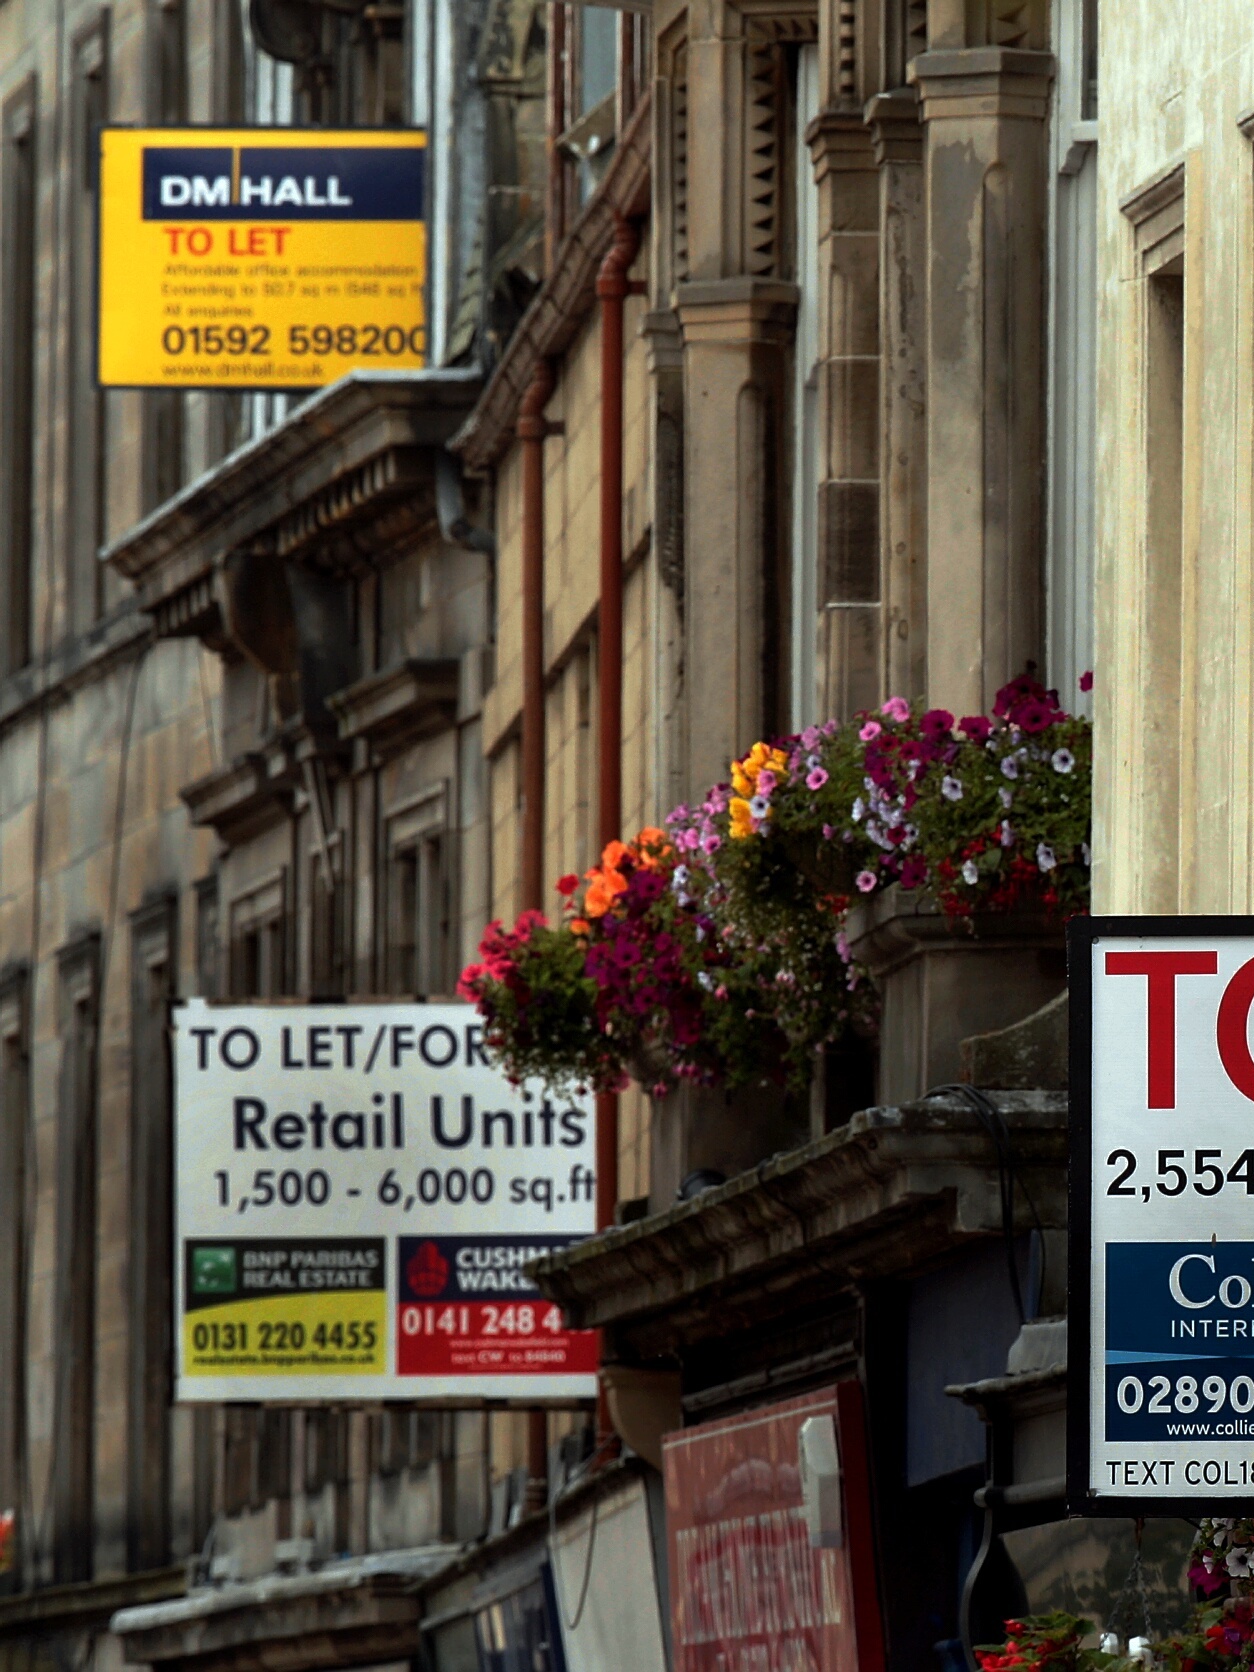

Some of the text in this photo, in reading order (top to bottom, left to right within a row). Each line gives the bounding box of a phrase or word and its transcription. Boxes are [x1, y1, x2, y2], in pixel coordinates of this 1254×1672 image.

[161, 176, 353, 206] DM HALL
[165, 228, 290, 256] TO LET
[163, 325, 425, 356] 01592 598200
[190, 1027, 260, 1070] TO
[234, 1091, 586, 1150] Retail Units
[217, 1164, 596, 1212] 1,500 - 6,000 sq.ft
[241, 1246, 381, 1270] BNP PARIBAS
[241, 1268, 375, 1290] REAL ESTATE
[403, 1307, 468, 1335] 0141
[482, 1305, 534, 1334] 248
[194, 1322, 376, 1351] 0131 220 4455
[1106, 1461, 1175, 1485] TEXT
